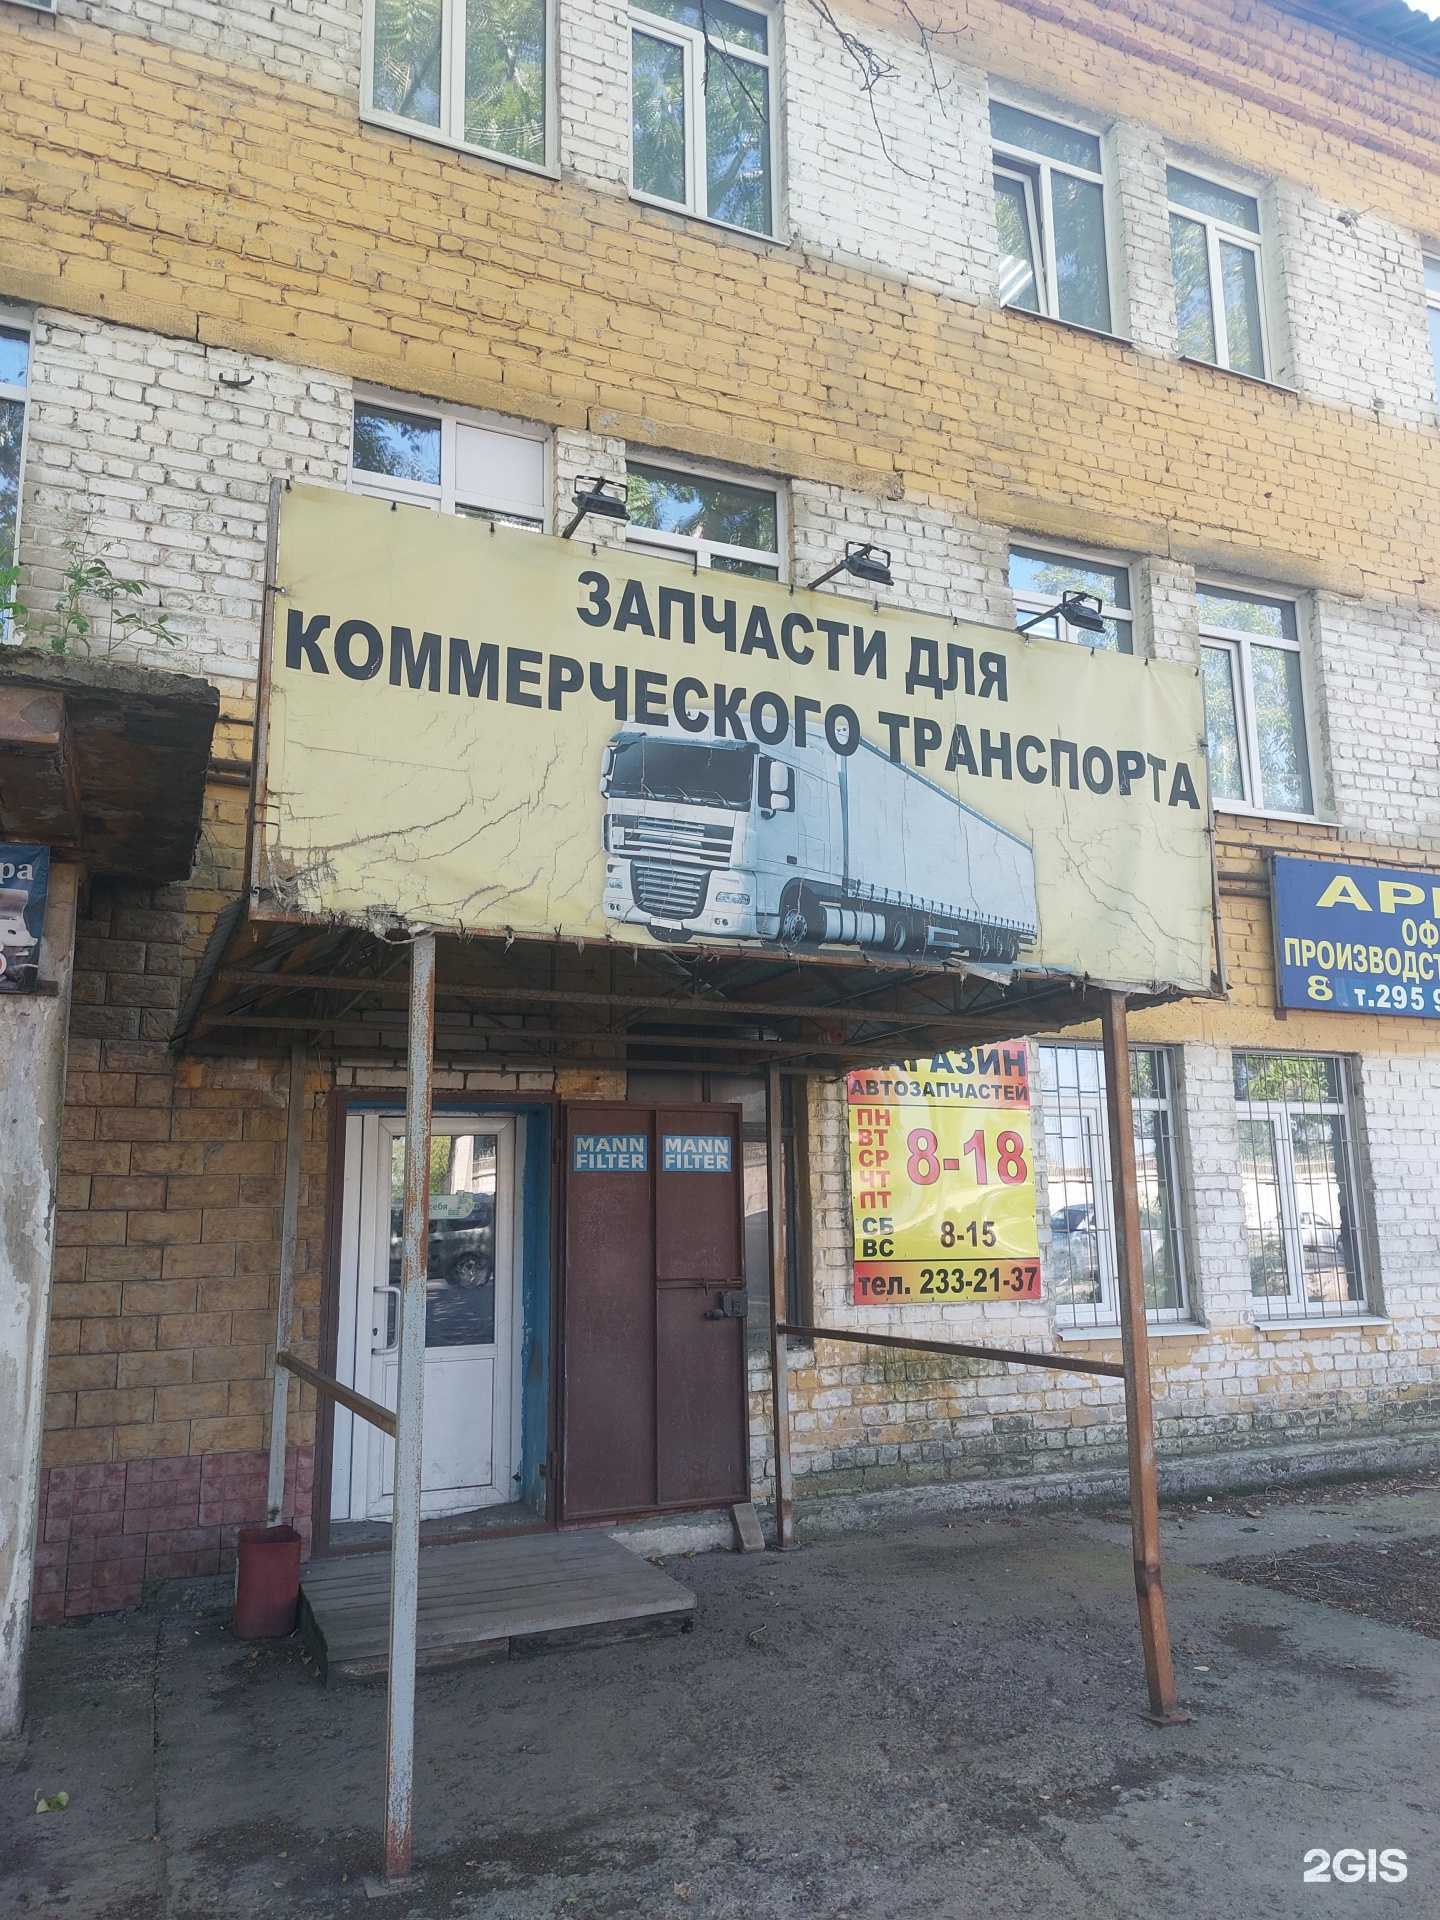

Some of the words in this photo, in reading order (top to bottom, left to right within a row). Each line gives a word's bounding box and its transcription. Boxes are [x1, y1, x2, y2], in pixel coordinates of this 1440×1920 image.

[576, 570, 888, 680] ЗАПЧАСТИ
[904, 635, 1010, 702] ДЛЯ
[285, 608, 861, 757] КОММЕРЧЕСКОГО
[878, 710, 1201, 811] ТРАНСПОРТА
[850, 1079, 1028, 1101] АВТОЗАПЧАСТЕЙ
[857, 1108, 891, 1126] ПН
[576, 1137, 644, 1153] MANN
[664, 1138, 729, 1153] MANN
[858, 1128, 888, 1146] ВТ
[576, 1153, 644, 1169] FILTER
[664, 1153, 729, 1169] FILTER
[859, 1150, 889, 1167] СР
[906, 1128, 1027, 1185] 8-18
[860, 1170, 890, 1187] ЧТ
[860, 1191, 892, 1209] ПТ
[862, 1217, 894, 1235] СБ
[940, 1221, 997, 1248] 8-15
[862, 1238, 894, 1257] ВС
[858, 1277, 911, 1296] тел.
[920, 1267, 1038, 1294] 233-21-37
